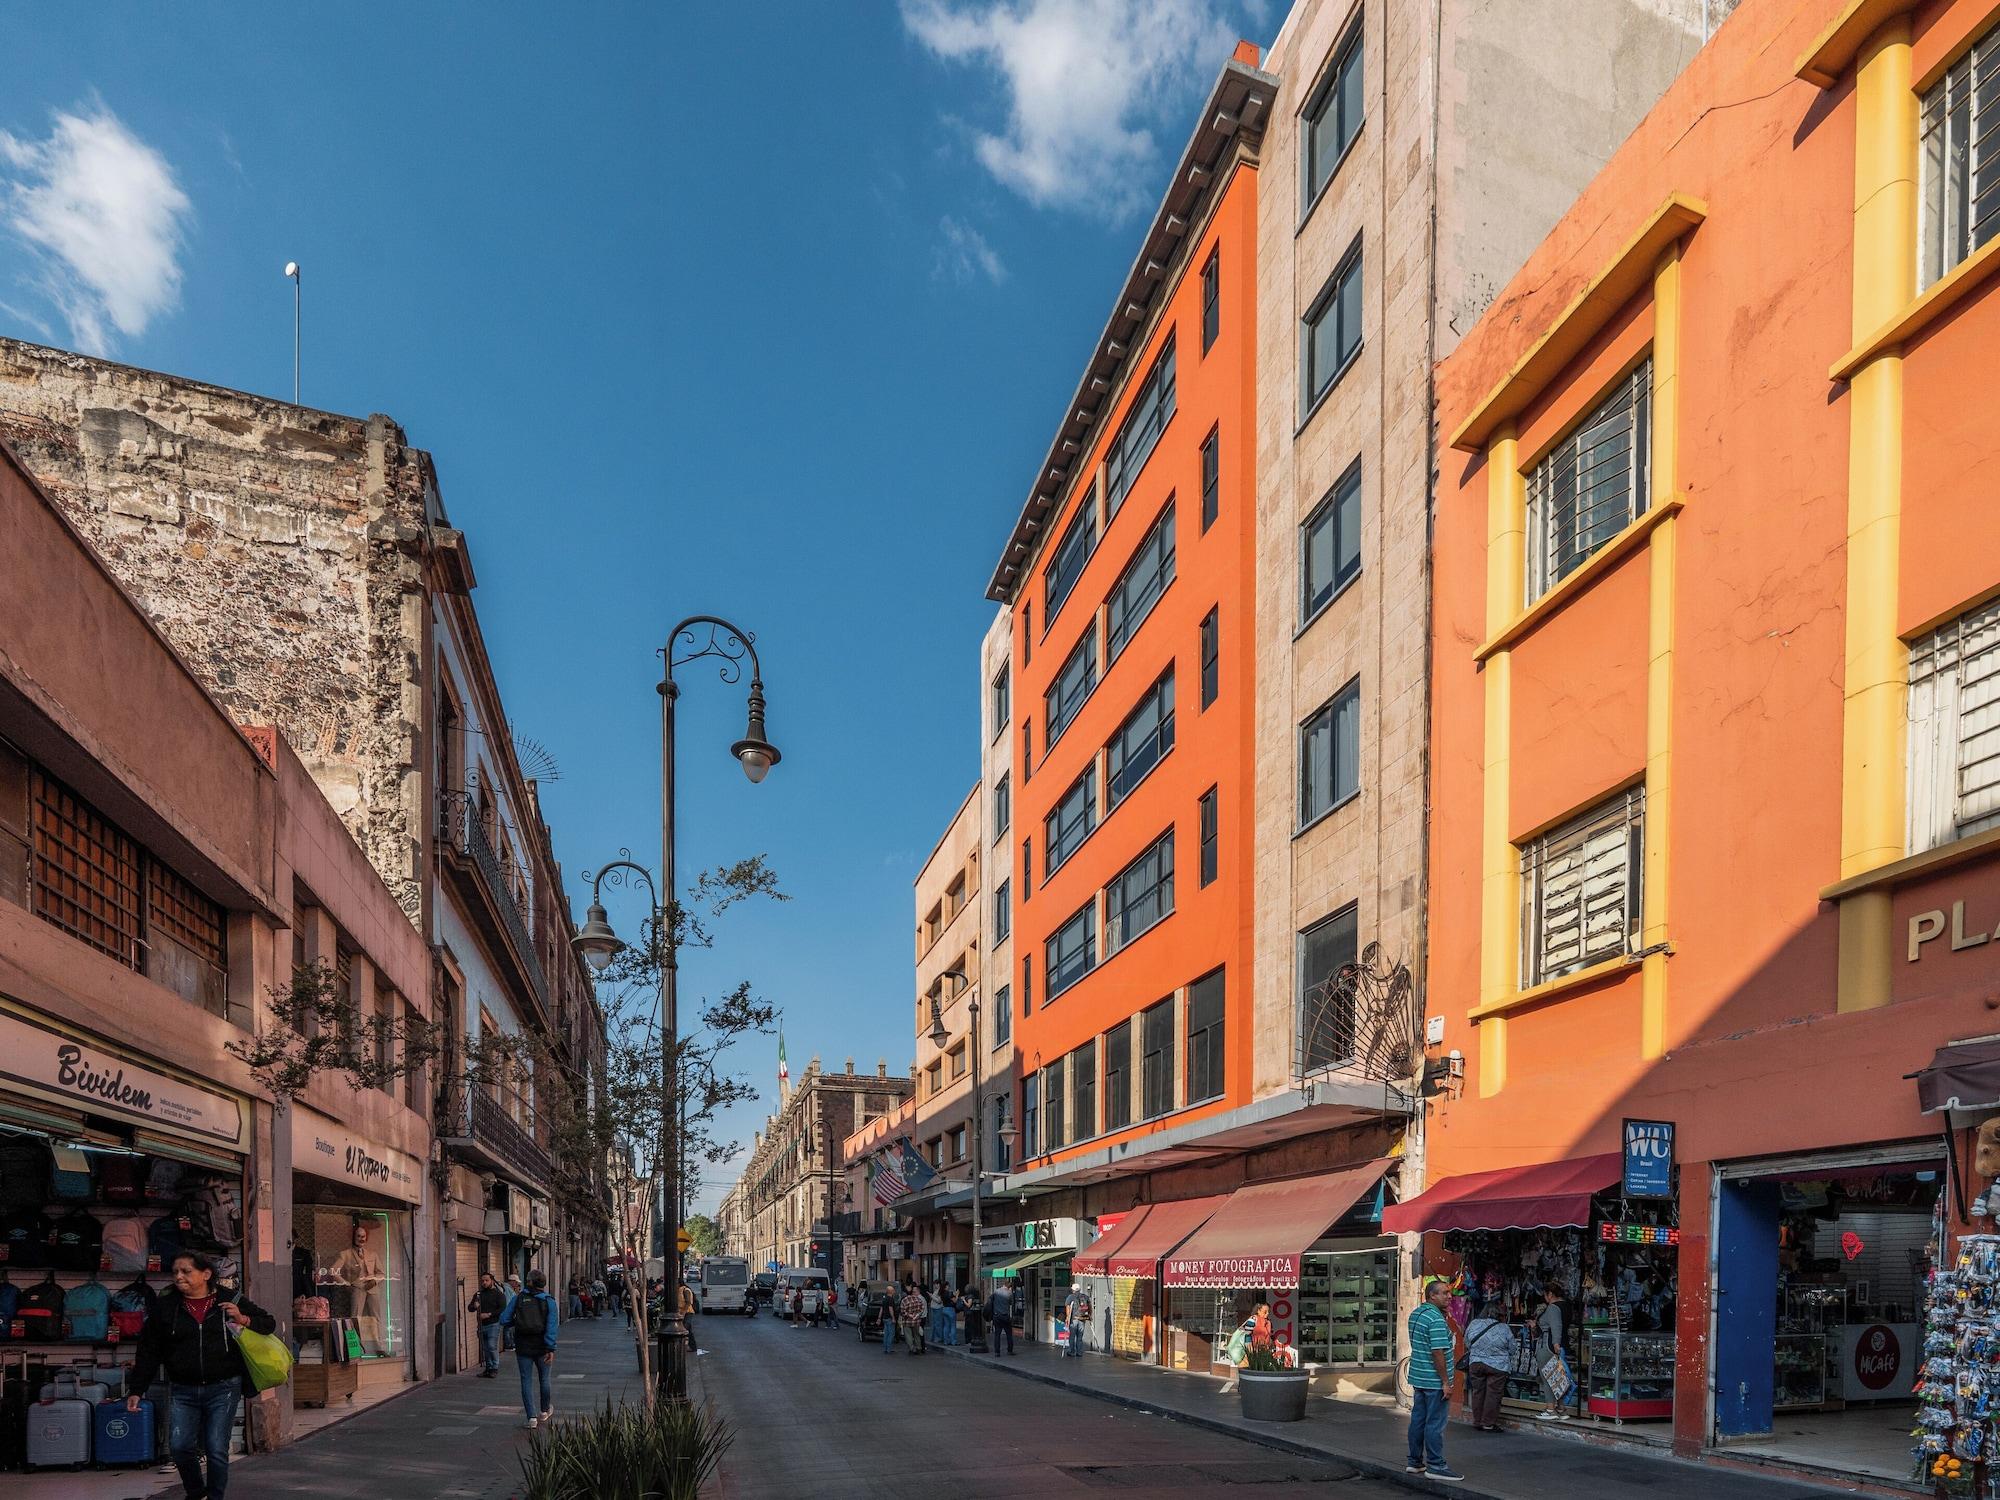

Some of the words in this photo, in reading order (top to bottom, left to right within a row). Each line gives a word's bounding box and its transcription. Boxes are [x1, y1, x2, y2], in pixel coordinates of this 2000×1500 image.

[57, 1044, 153, 1111] Bividem
[315, 1137, 336, 1158] Boutique
[1629, 1126, 1668, 1158] WC
[1115, 1265, 1139, 1274] Brasil
[1170, 1260, 1205, 1274] MONEY
[1208, 1258, 1293, 1274] FOTOGRAFICA
[1860, 1352, 1895, 1374] MiCafé
